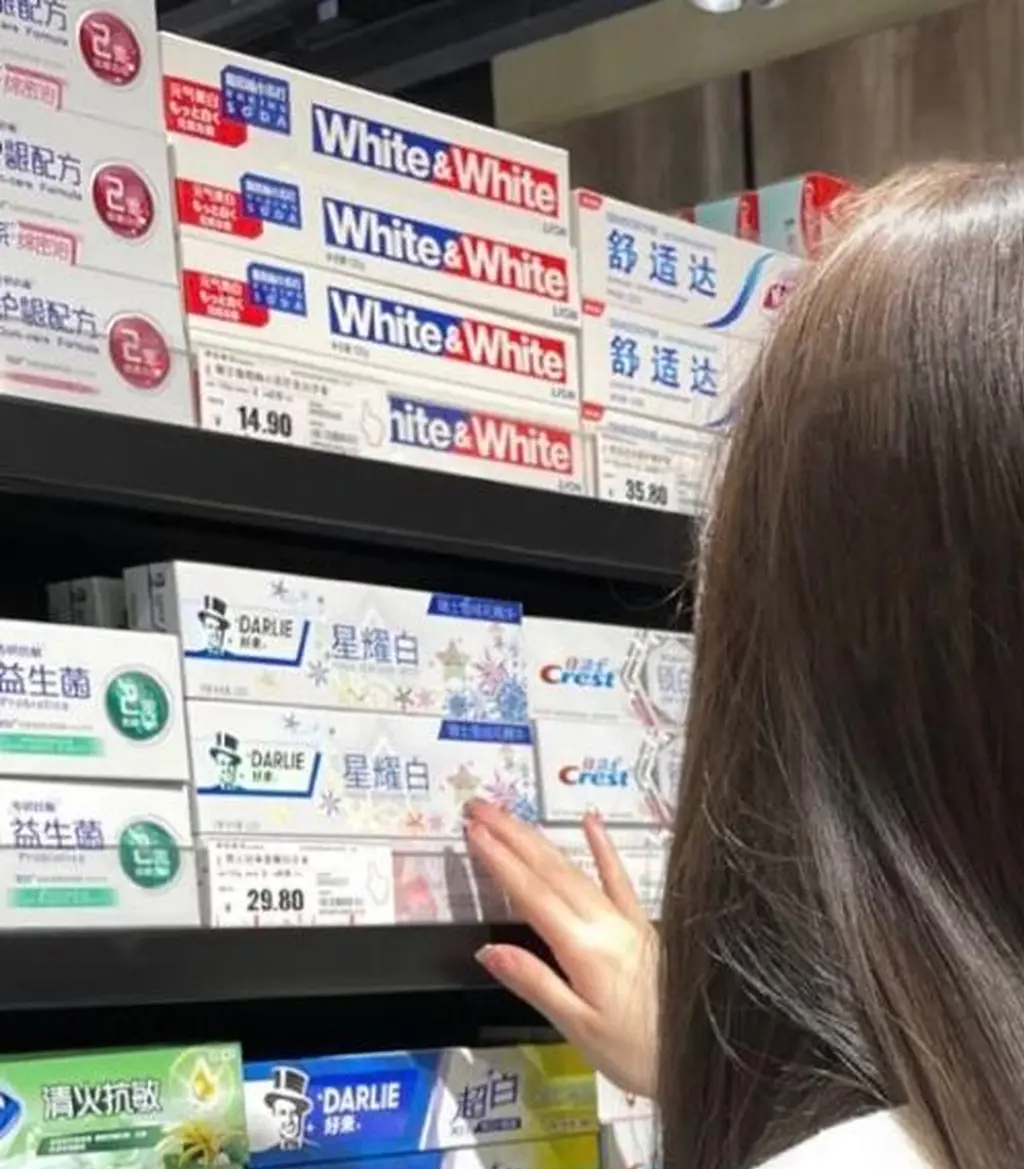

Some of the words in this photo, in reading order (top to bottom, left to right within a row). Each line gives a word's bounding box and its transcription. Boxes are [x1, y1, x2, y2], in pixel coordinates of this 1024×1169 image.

[313, 107, 556, 213] White&White
[325, 200, 566, 299] White&White
[607, 228, 717, 298] 舒适达
[330, 289, 564, 382] White&White
[610, 334, 718, 398] 舒适达
[236, 405, 293, 438] 14.90
[238, 615, 293, 638] DARLIE
[332, 623, 419, 666] 星耀白
[0, 662, 91, 699] 益生菌
[539, 664, 615, 689] Crest
[251, 750, 305, 770] DARLIE
[343, 753, 429, 791] 星耀白
[558, 765, 629, 788] Crest
[246, 888, 304, 912] 29.80
[42, 1078, 163, 1122] 清火抗敏
[323, 1082, 401, 1114] DARLIE
[452, 1069, 519, 1122] 超白
